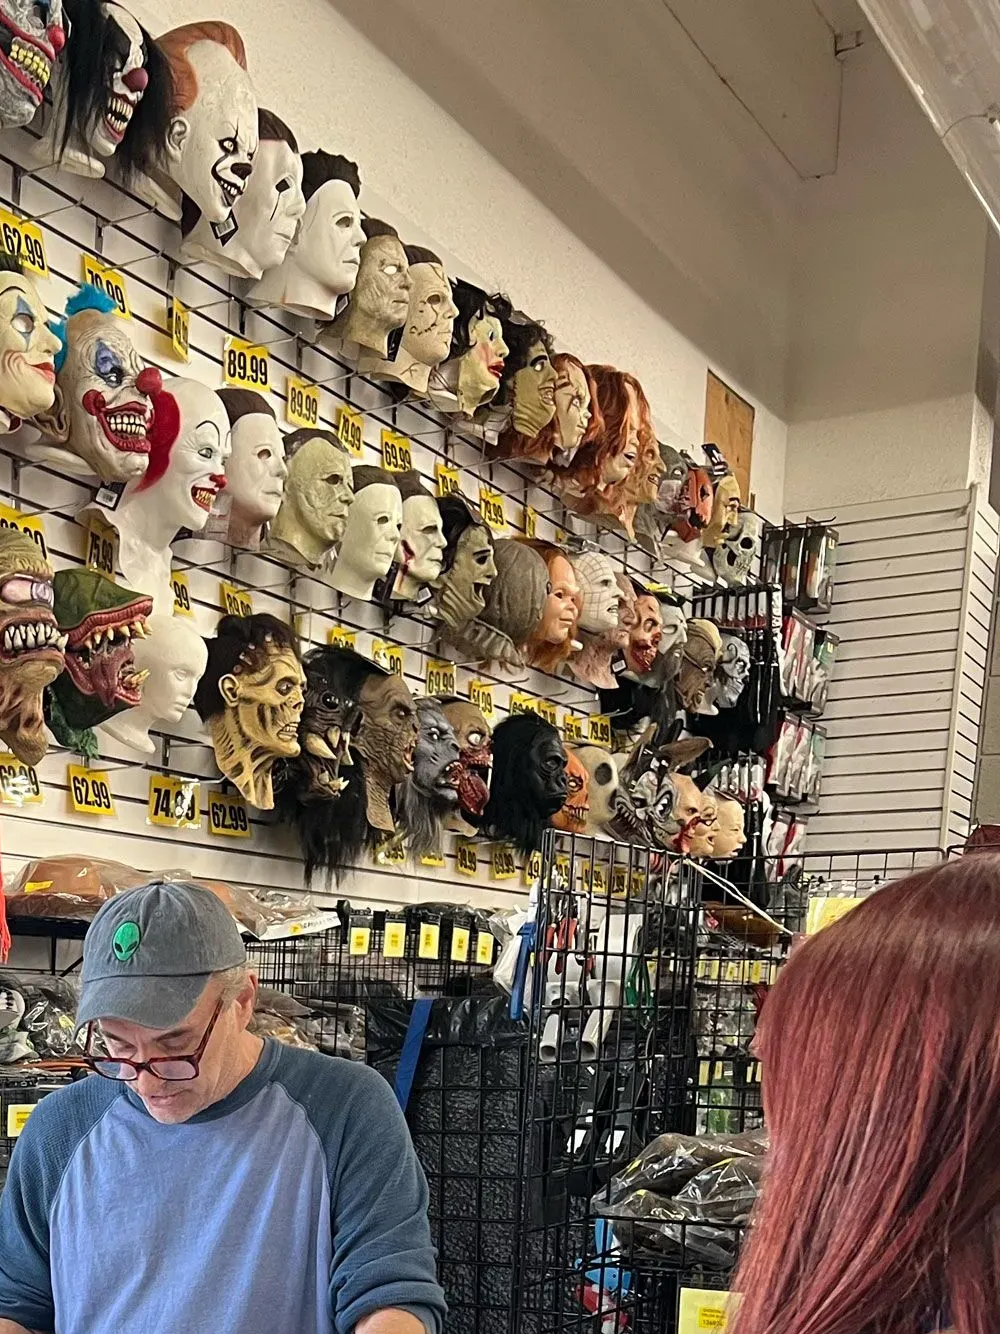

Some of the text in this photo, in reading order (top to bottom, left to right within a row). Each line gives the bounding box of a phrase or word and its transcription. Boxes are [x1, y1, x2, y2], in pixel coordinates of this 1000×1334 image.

[227, 349, 268, 386] 89.99
[290, 387, 318, 424] 89.99
[341, 413, 361, 451] 79.99
[385, 442, 411, 471] 69.99
[73, 776, 110, 809] 62.99
[211, 802, 248, 831] 62.99
